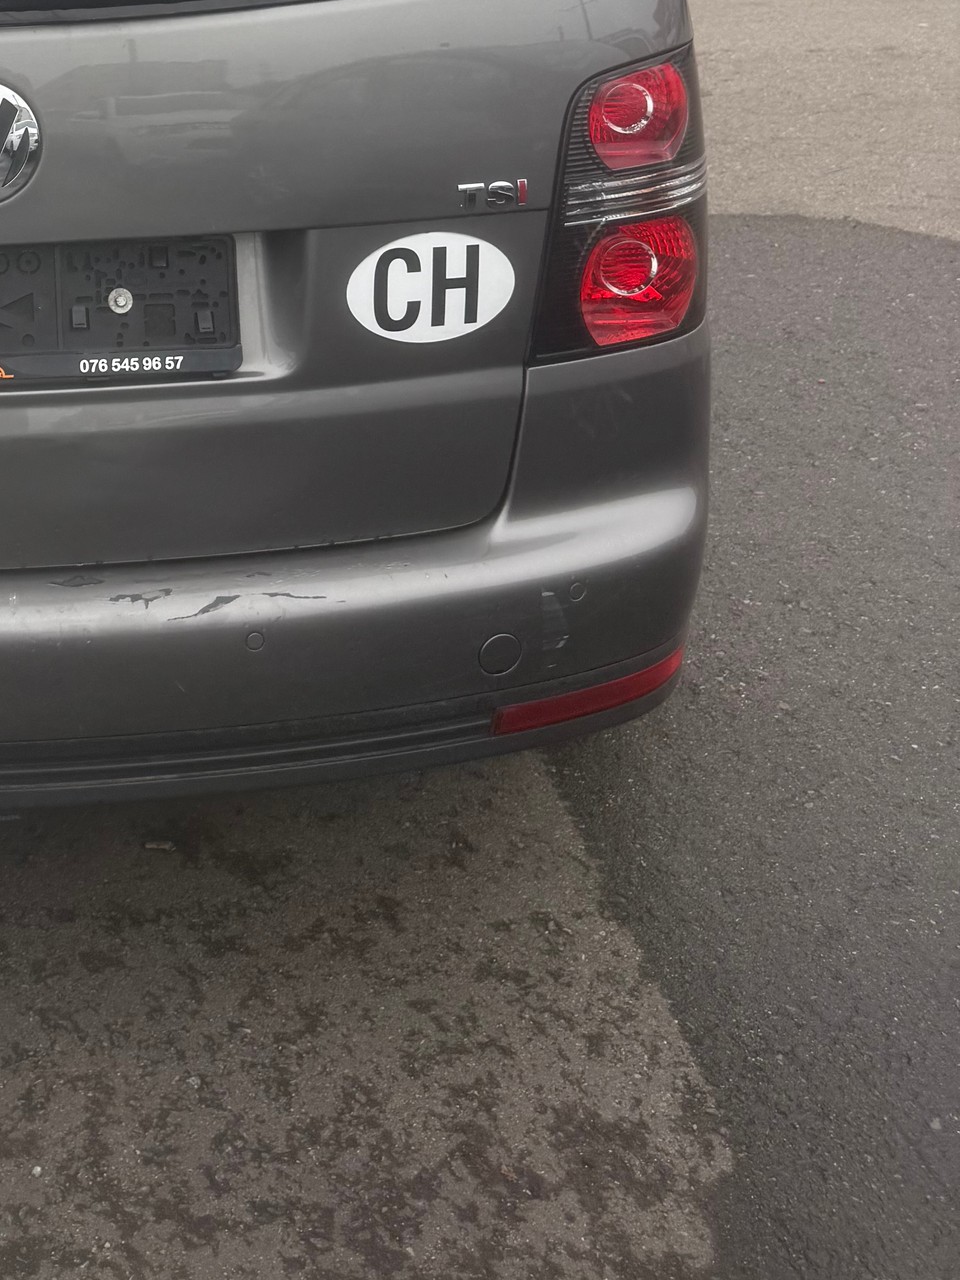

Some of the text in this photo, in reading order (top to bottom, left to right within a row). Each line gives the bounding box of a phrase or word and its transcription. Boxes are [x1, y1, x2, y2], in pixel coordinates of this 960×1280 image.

[457, 178, 528, 210] TSI
[373, 243, 480, 332] CH
[79, 355, 184, 373] 076 545 96 57
